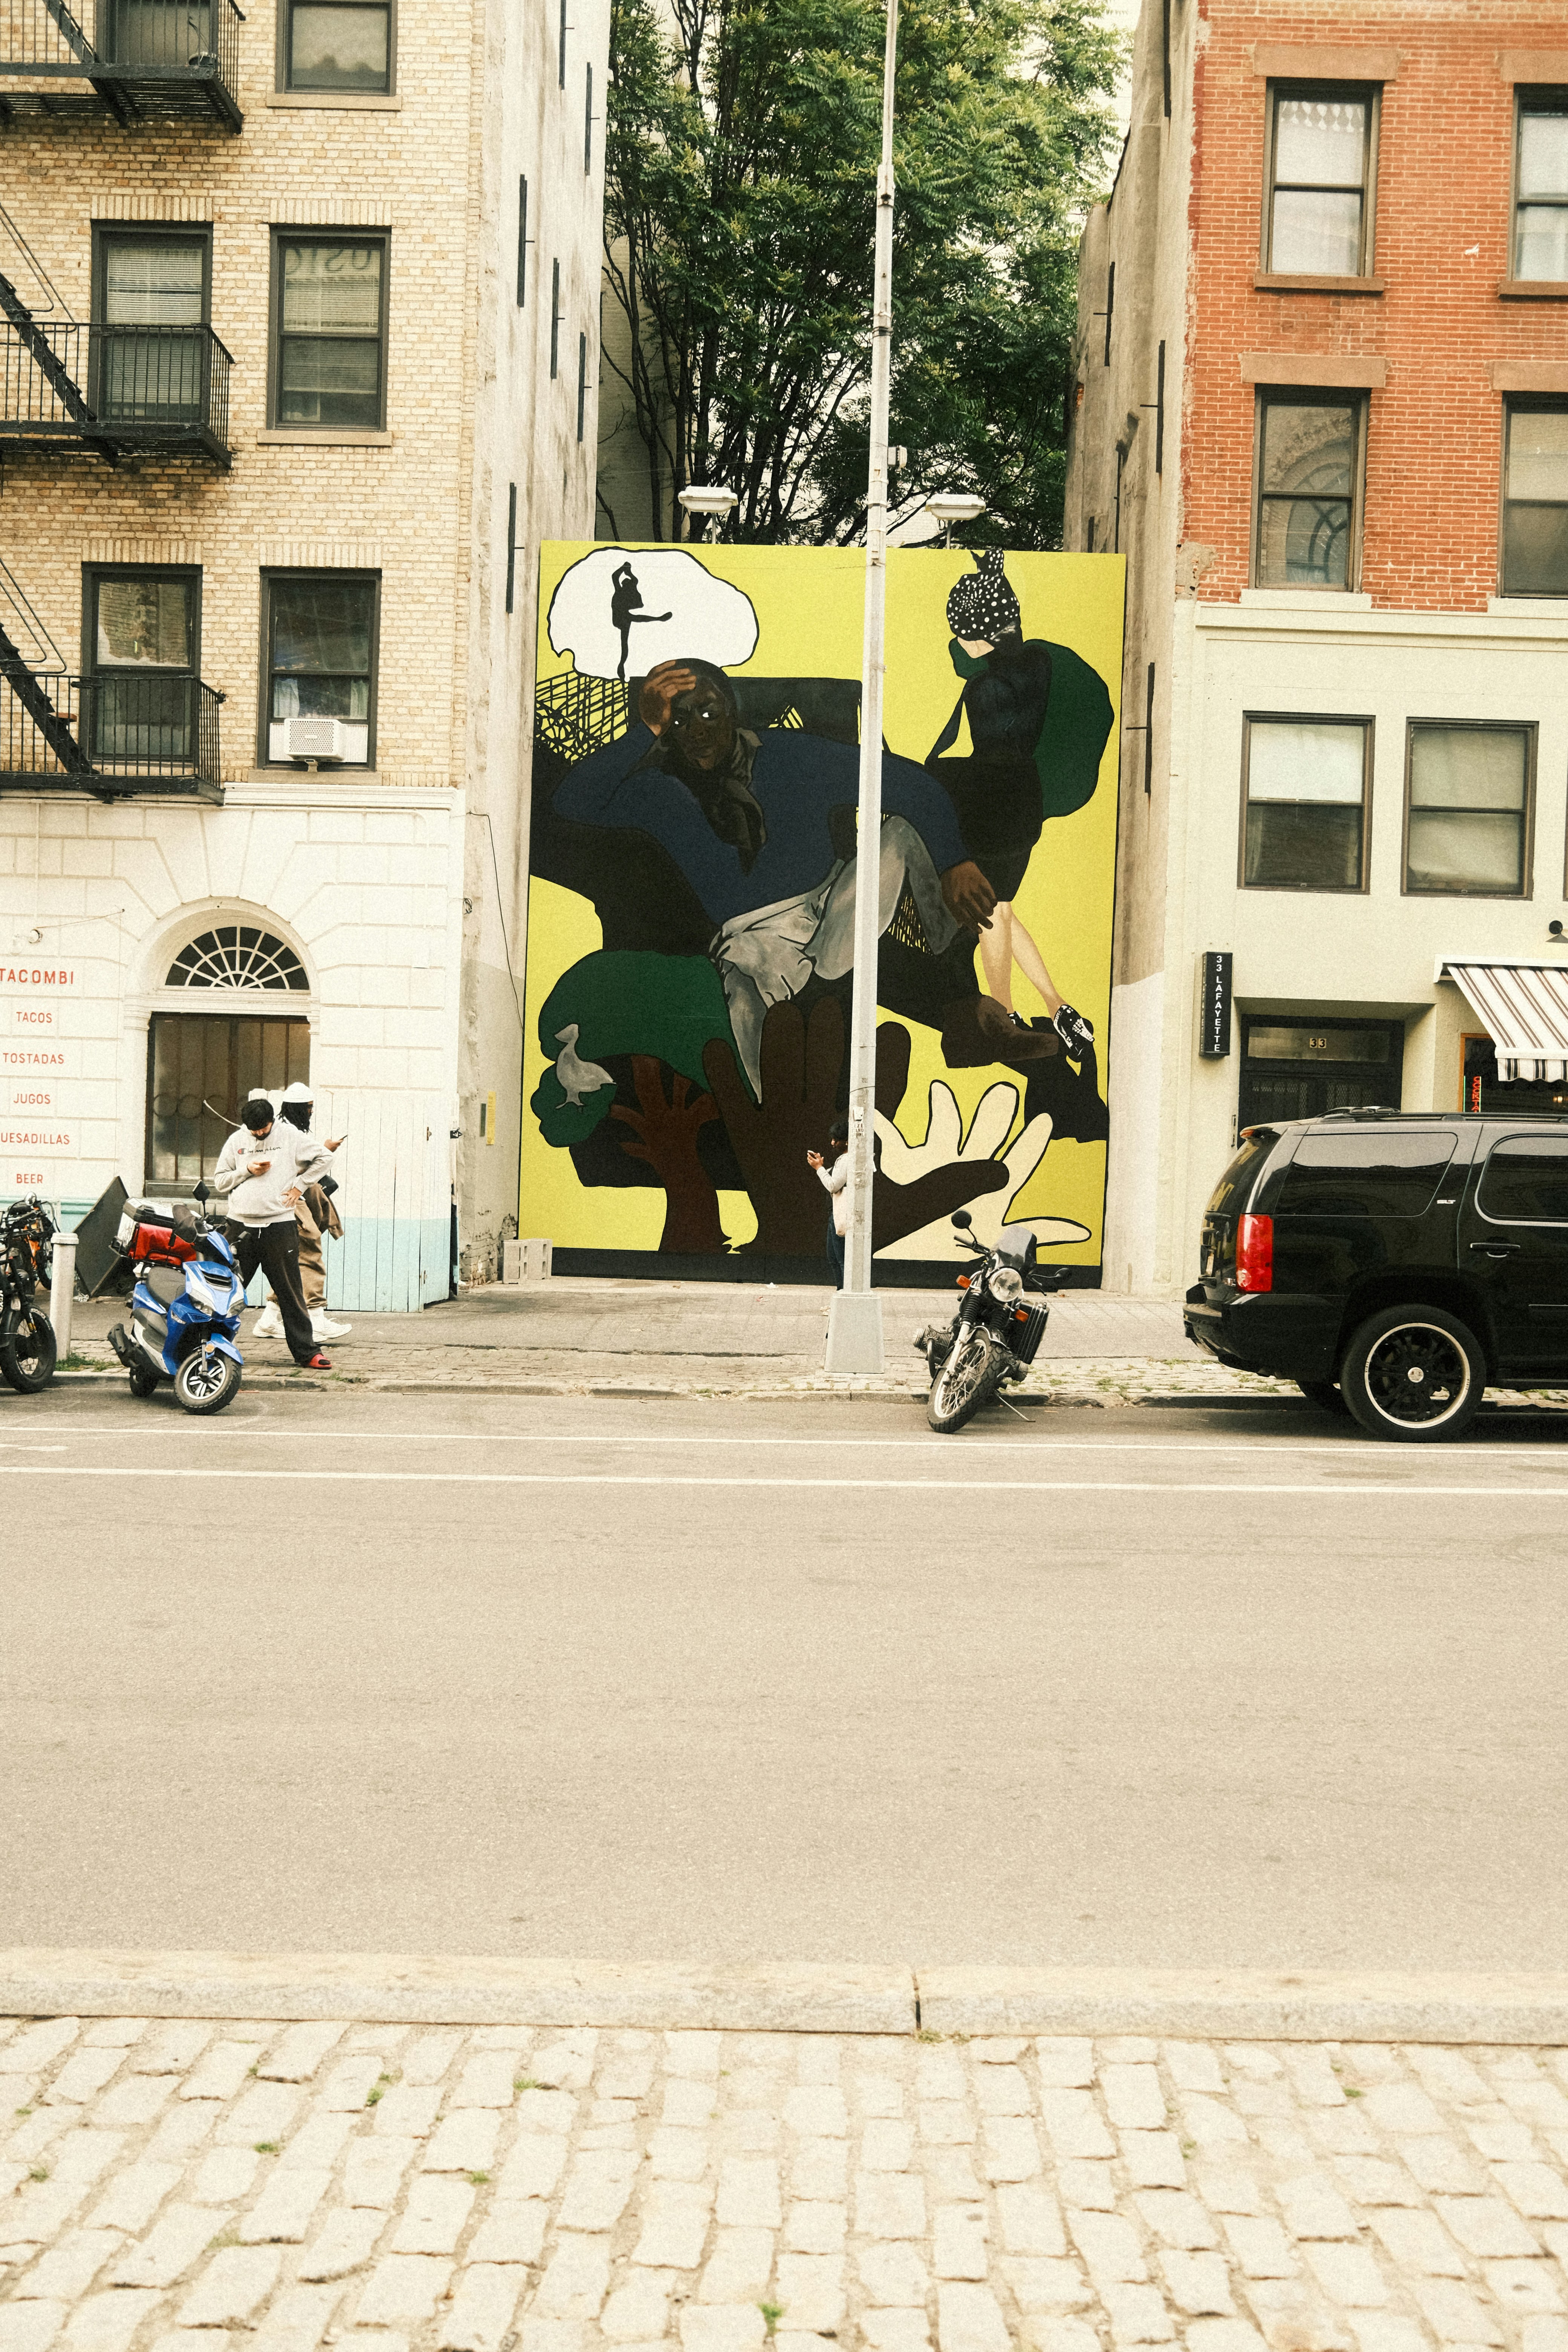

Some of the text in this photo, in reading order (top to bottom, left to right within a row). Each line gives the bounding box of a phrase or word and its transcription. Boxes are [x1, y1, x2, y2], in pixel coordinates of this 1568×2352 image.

[0, 968, 74, 985] TACOMBI
[1214, 956, 1222, 1051] 33 LAFAYETTE
[16, 1012, 52, 1023] TACOS
[1311, 1038, 1325, 1047] 33
[3, 1053, 64, 1064] TOSTADAS
[14, 1093, 51, 1104] JUGOS
[17, 1174, 43, 1184] BEER
